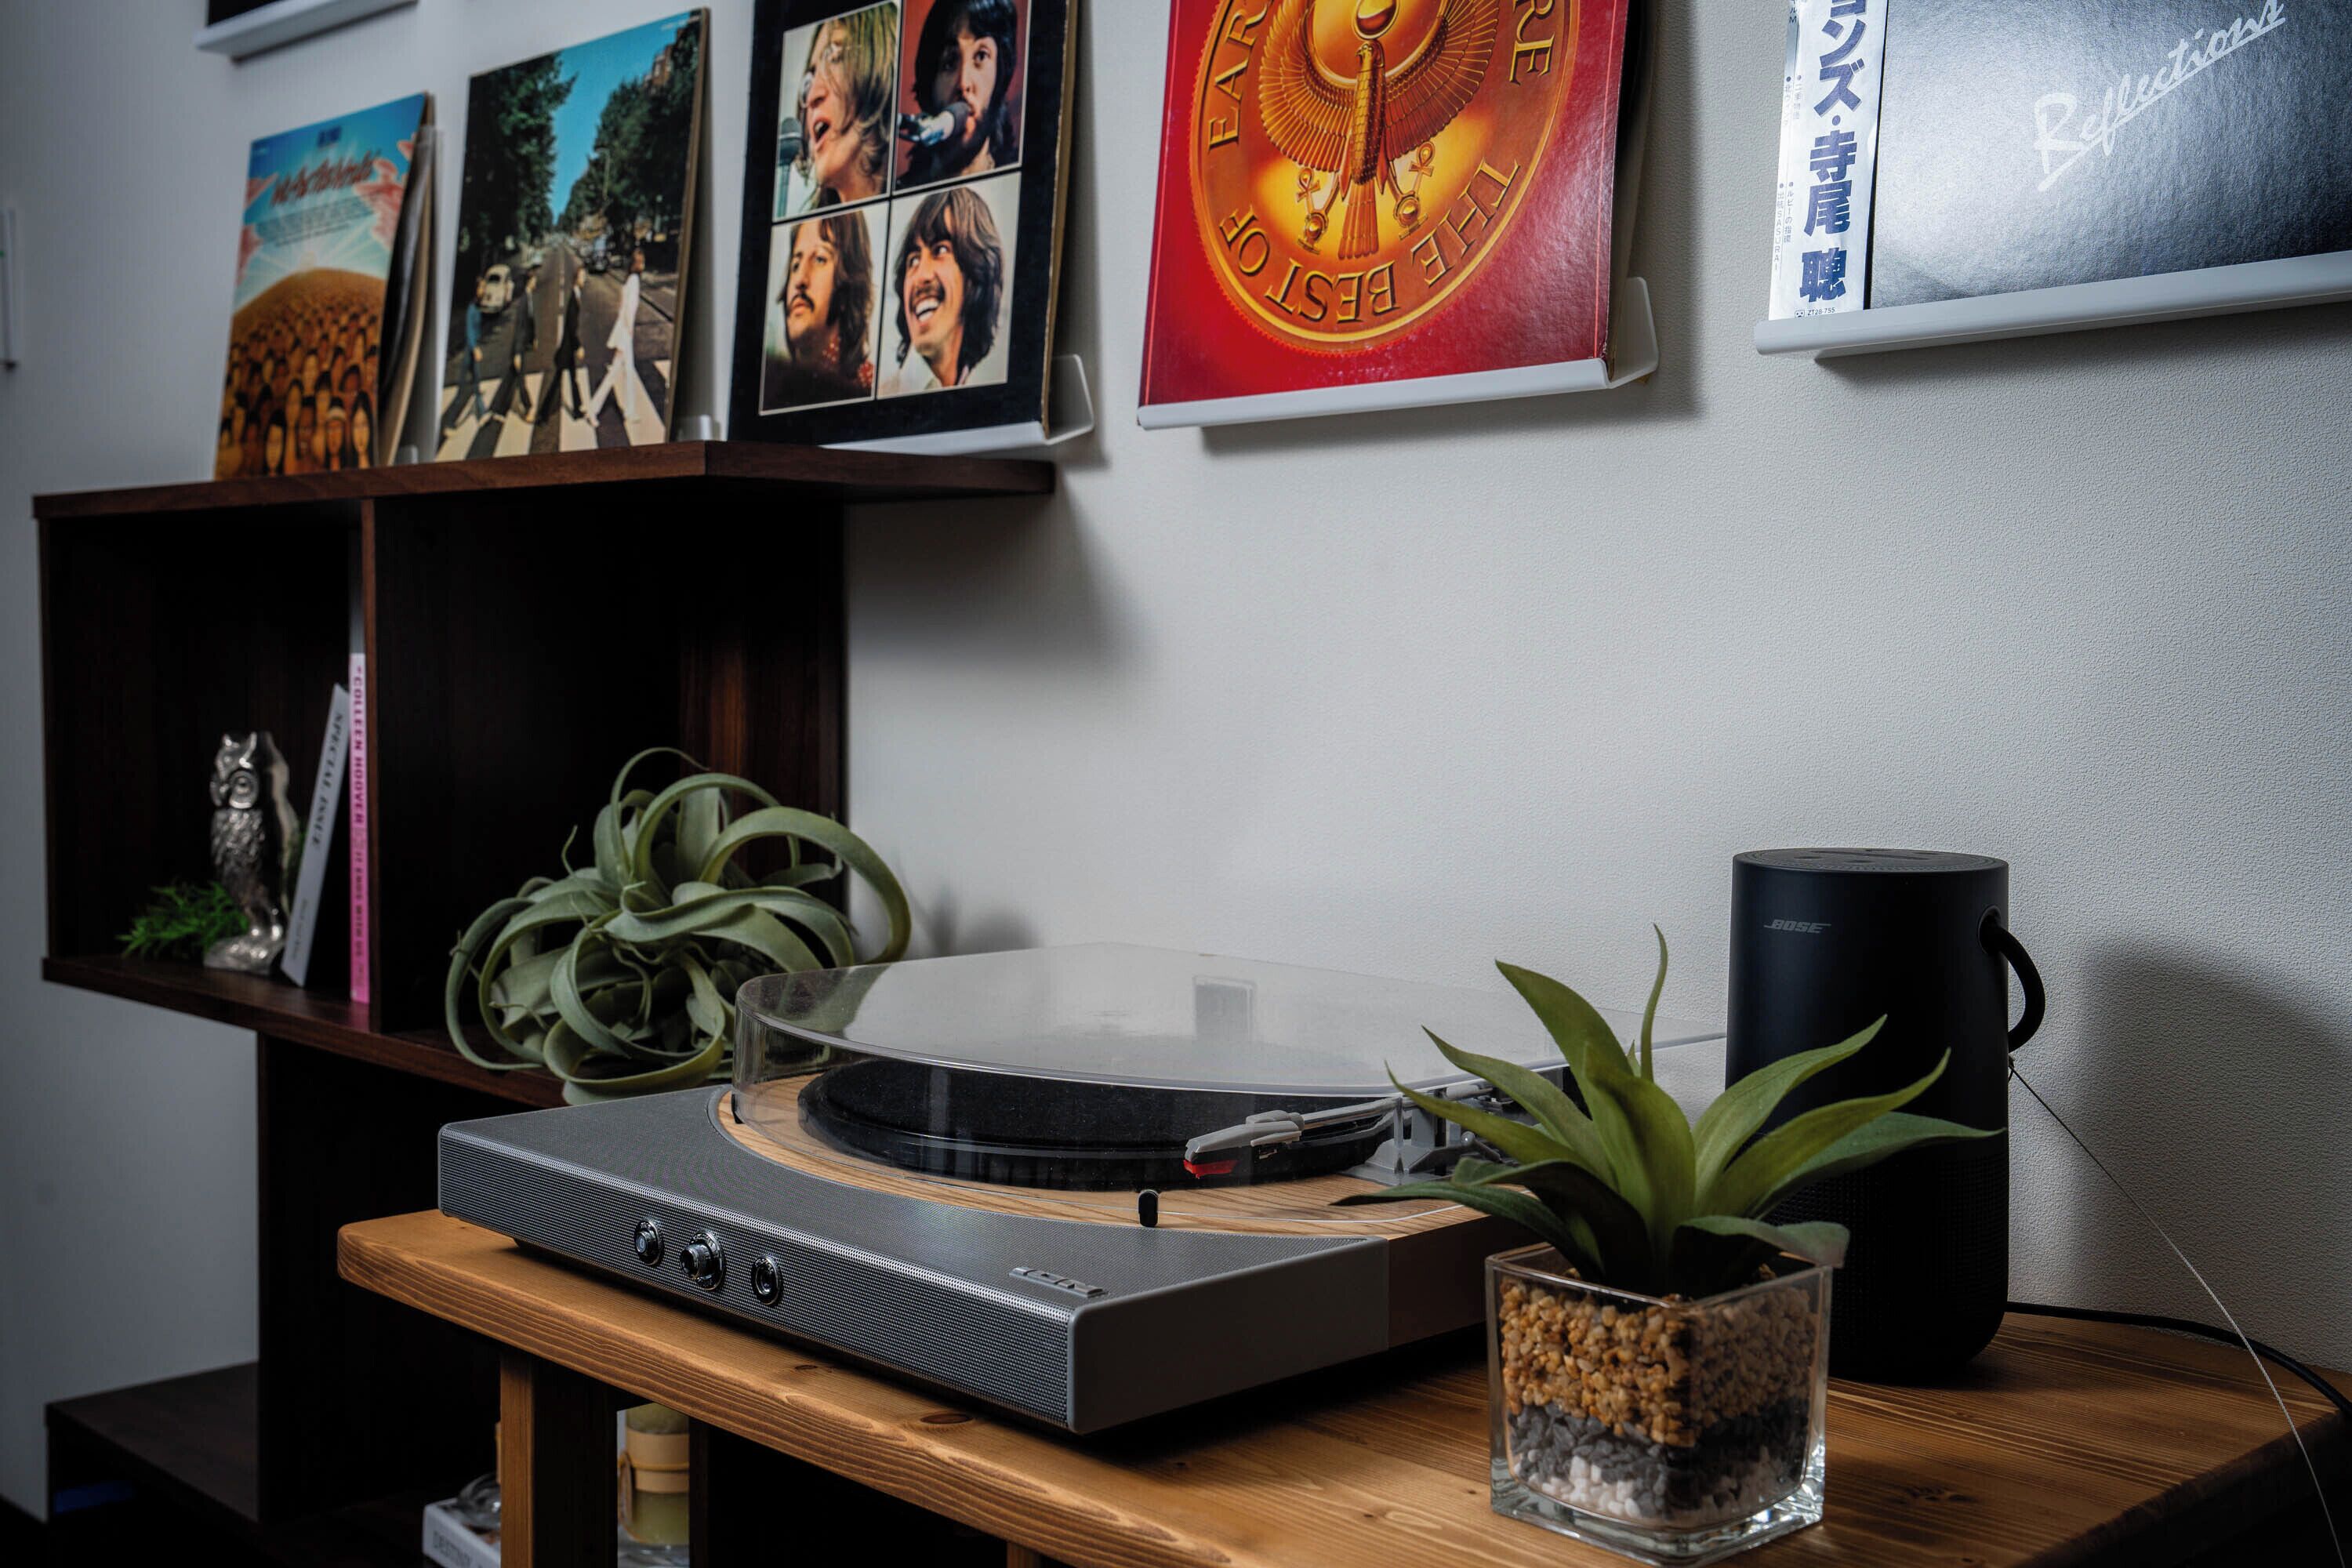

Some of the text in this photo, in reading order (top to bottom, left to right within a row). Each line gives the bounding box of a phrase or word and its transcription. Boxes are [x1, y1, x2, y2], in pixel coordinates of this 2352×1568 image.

[2034, 0, 2285, 188] Reflections
[1218, 157, 1521, 324] THE BEST OF
[353, 676, 365, 824] COLLEEN HOOVER
[1763, 919, 1831, 934] BOSE
